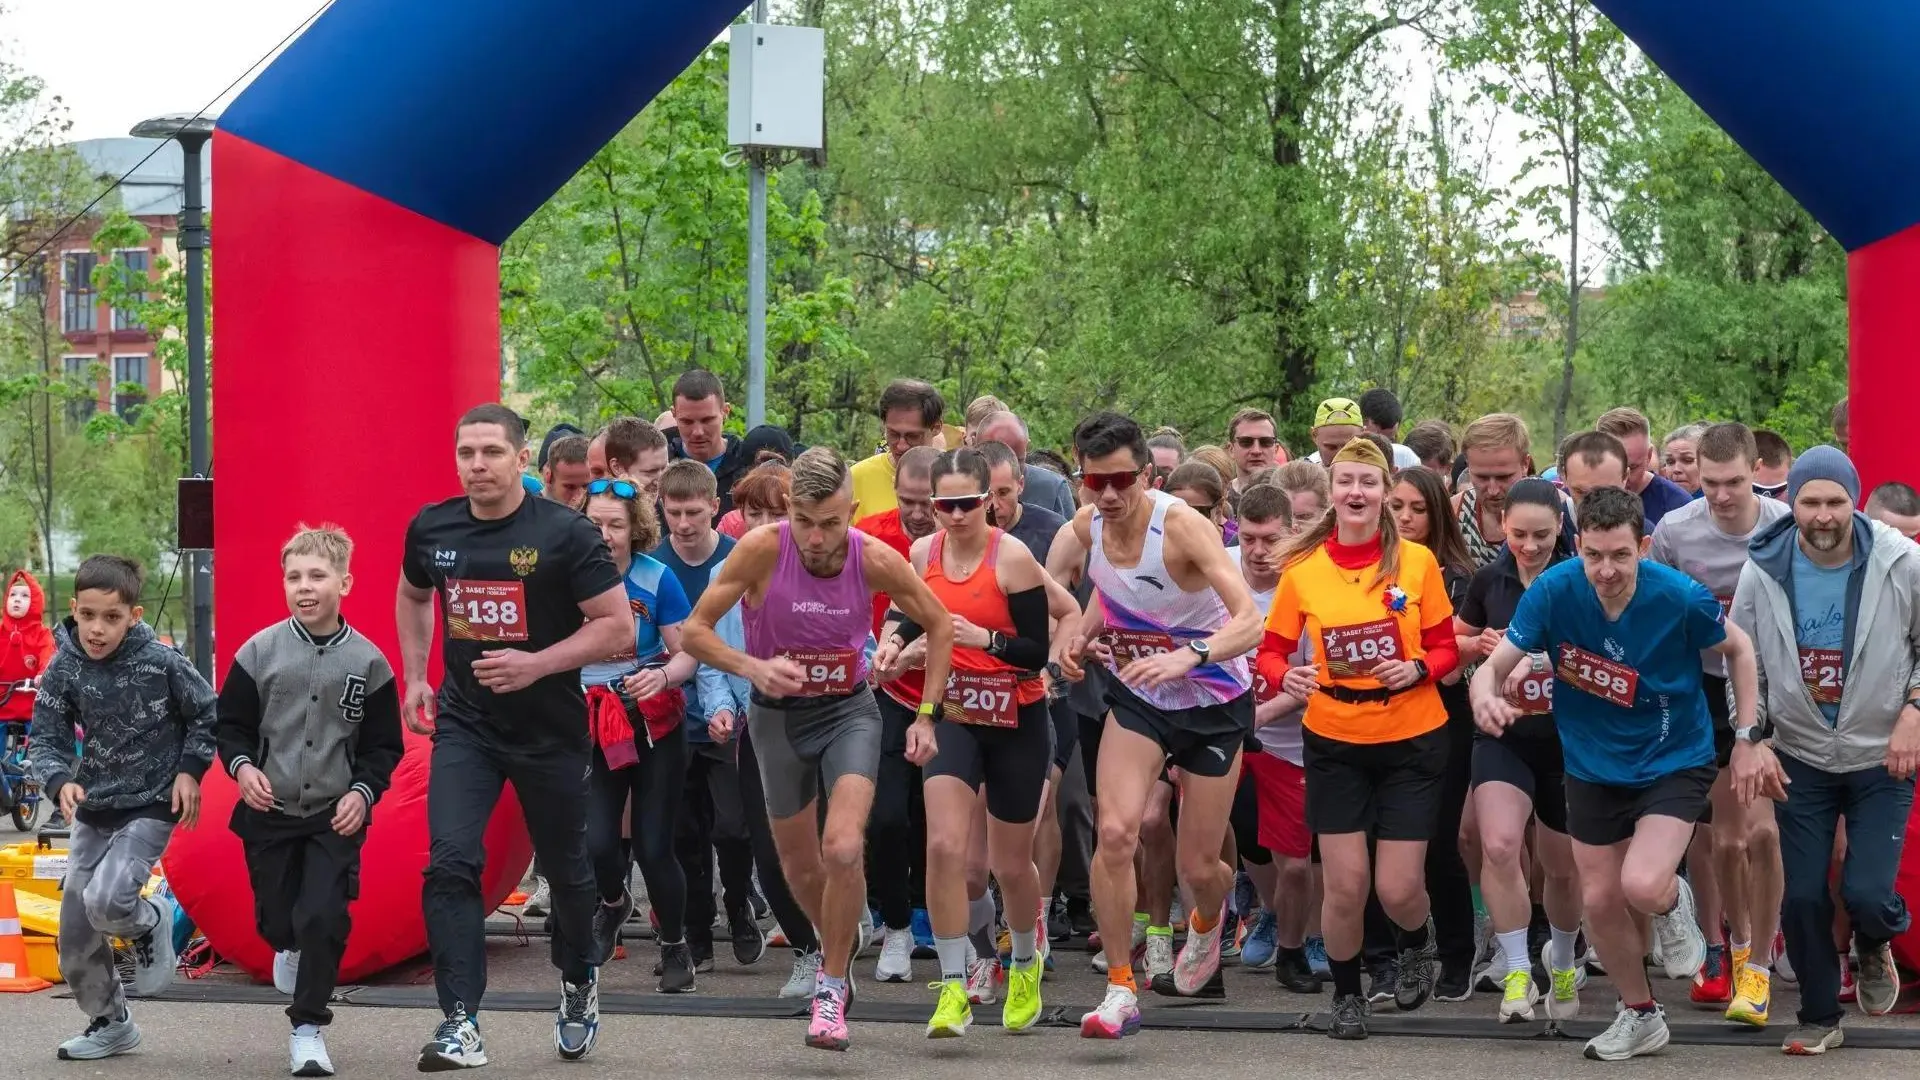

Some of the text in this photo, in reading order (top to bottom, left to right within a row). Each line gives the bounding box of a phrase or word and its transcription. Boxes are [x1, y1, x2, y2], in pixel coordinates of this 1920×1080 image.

[465, 586, 486, 594] ЗАБЕГ
[467, 600, 519, 624] 138
[1341, 629, 1363, 637] ЗАБЕГ
[1345, 635, 1397, 663] 193
[961, 675, 980, 683] ЗАБЕГ
[1578, 664, 1629, 694] 198
[962, 687, 1011, 713] 207
